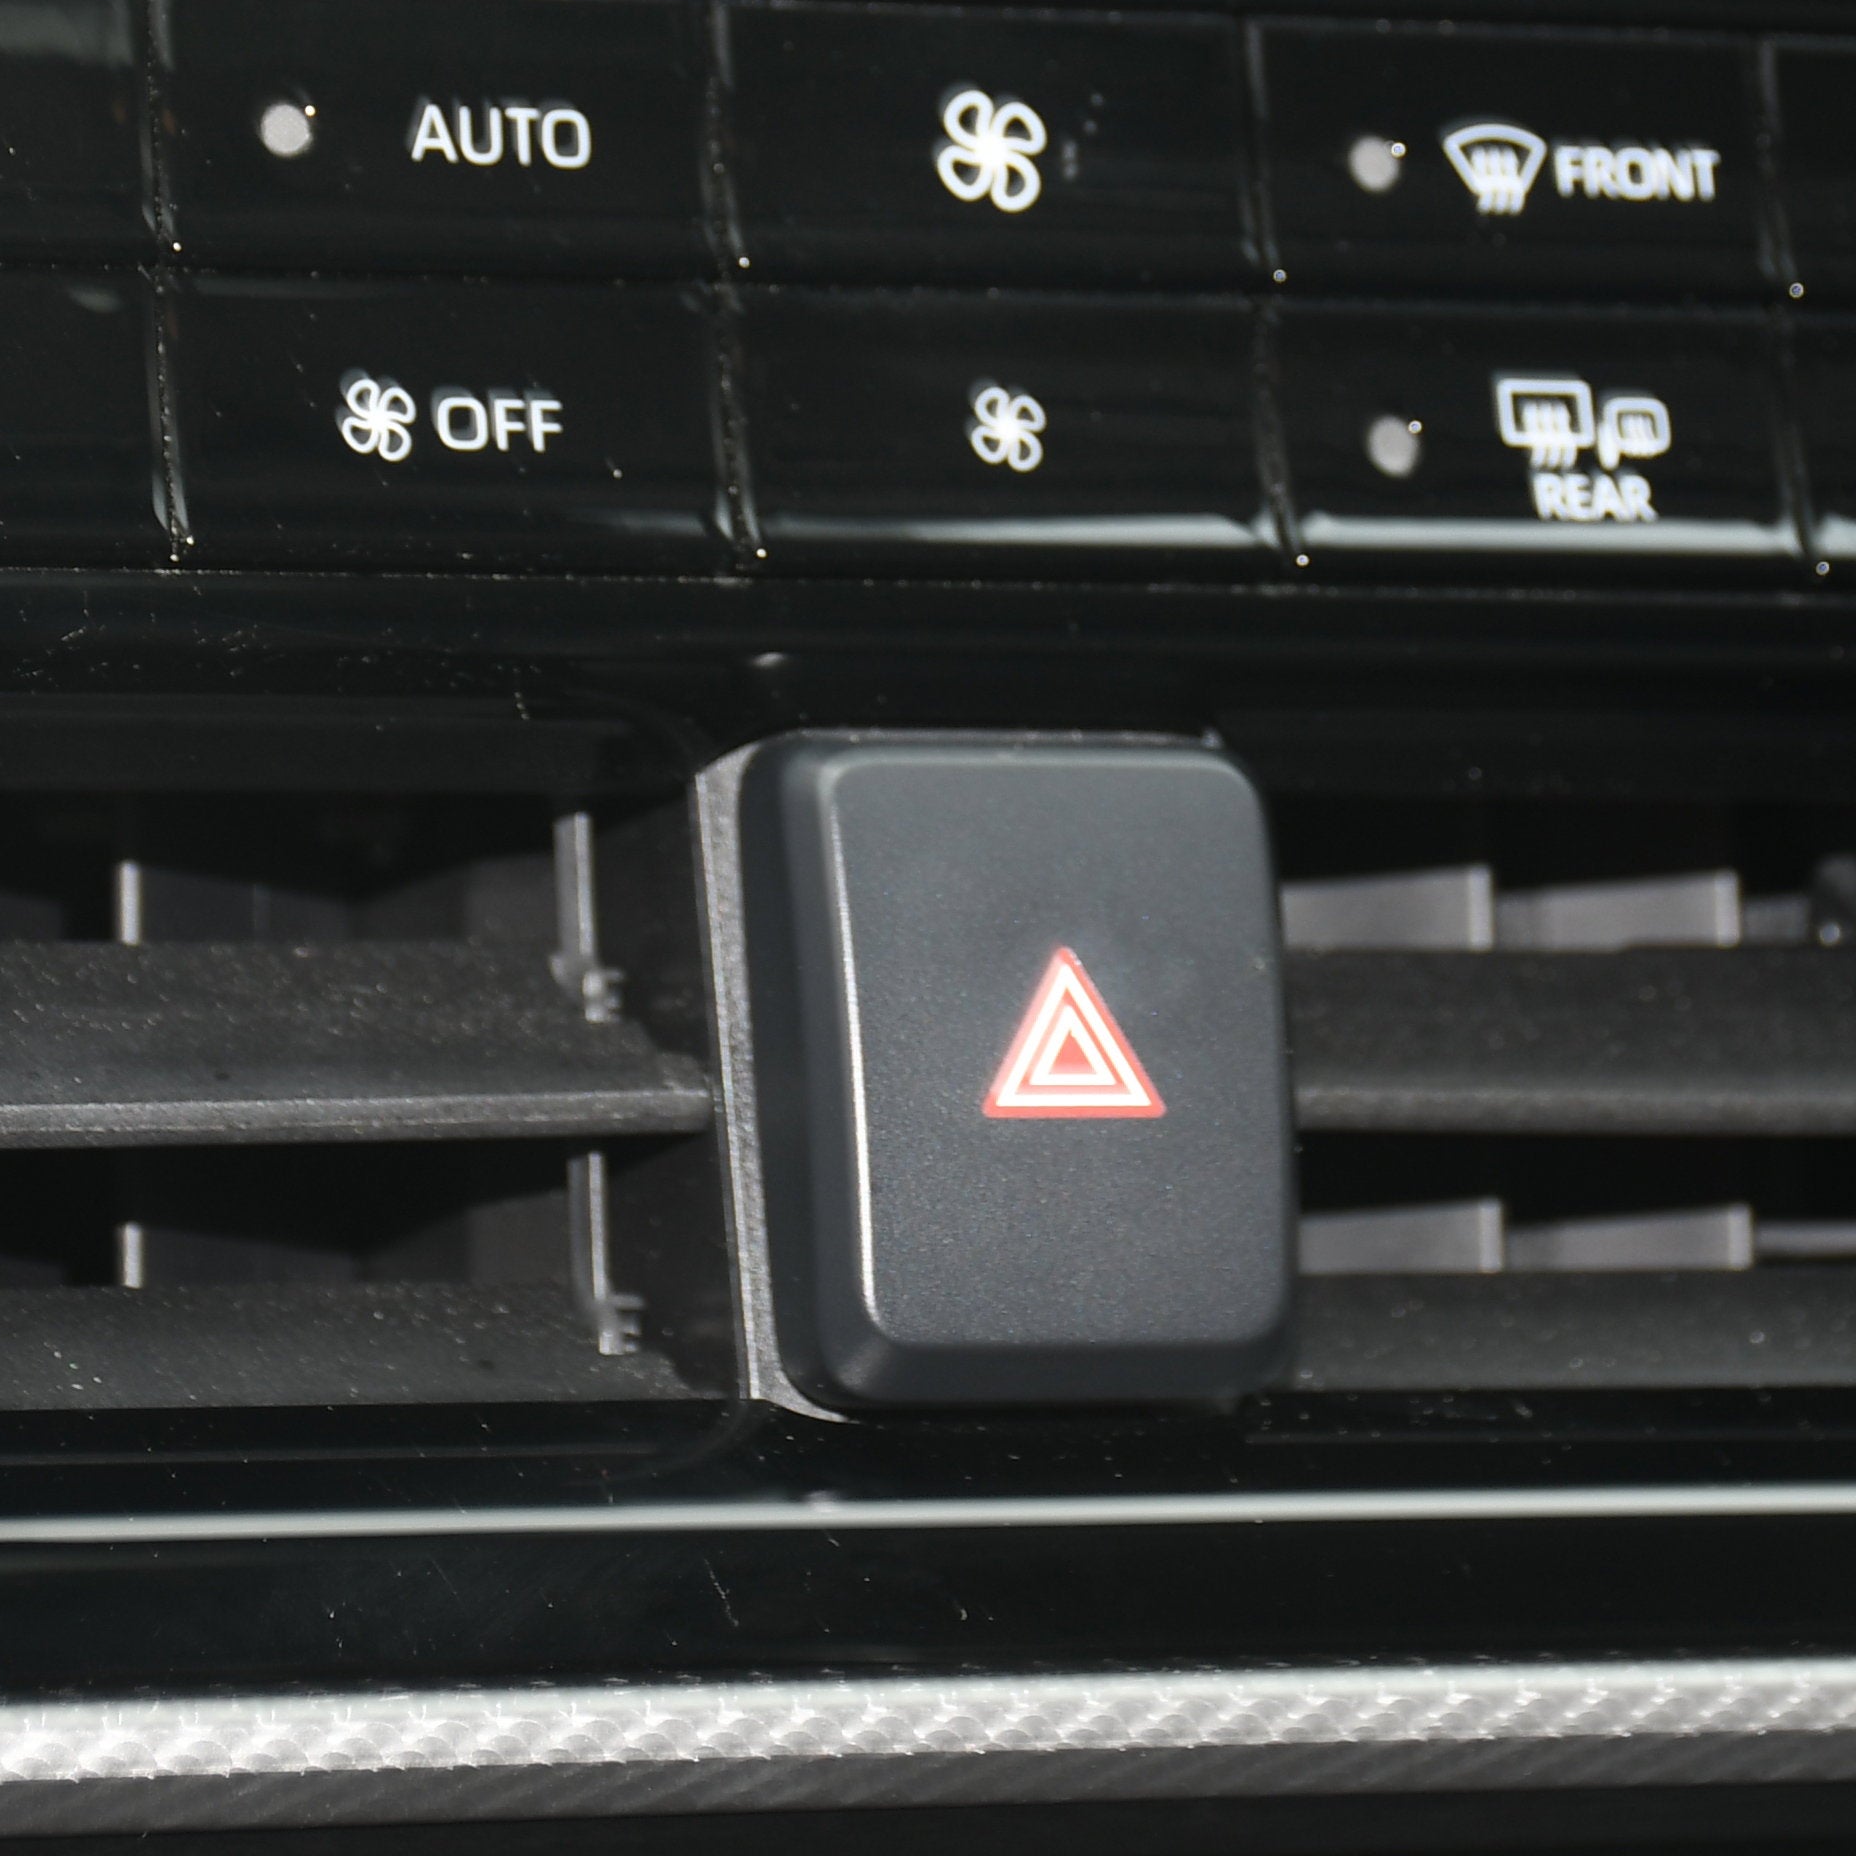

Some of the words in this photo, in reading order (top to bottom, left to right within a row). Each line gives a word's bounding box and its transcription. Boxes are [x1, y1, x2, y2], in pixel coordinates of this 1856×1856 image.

[410, 101, 594, 170] AUTO
[1554, 144, 1720, 202] FRONT
[434, 393, 564, 453] OFF
[1532, 470, 1656, 524] REAR
